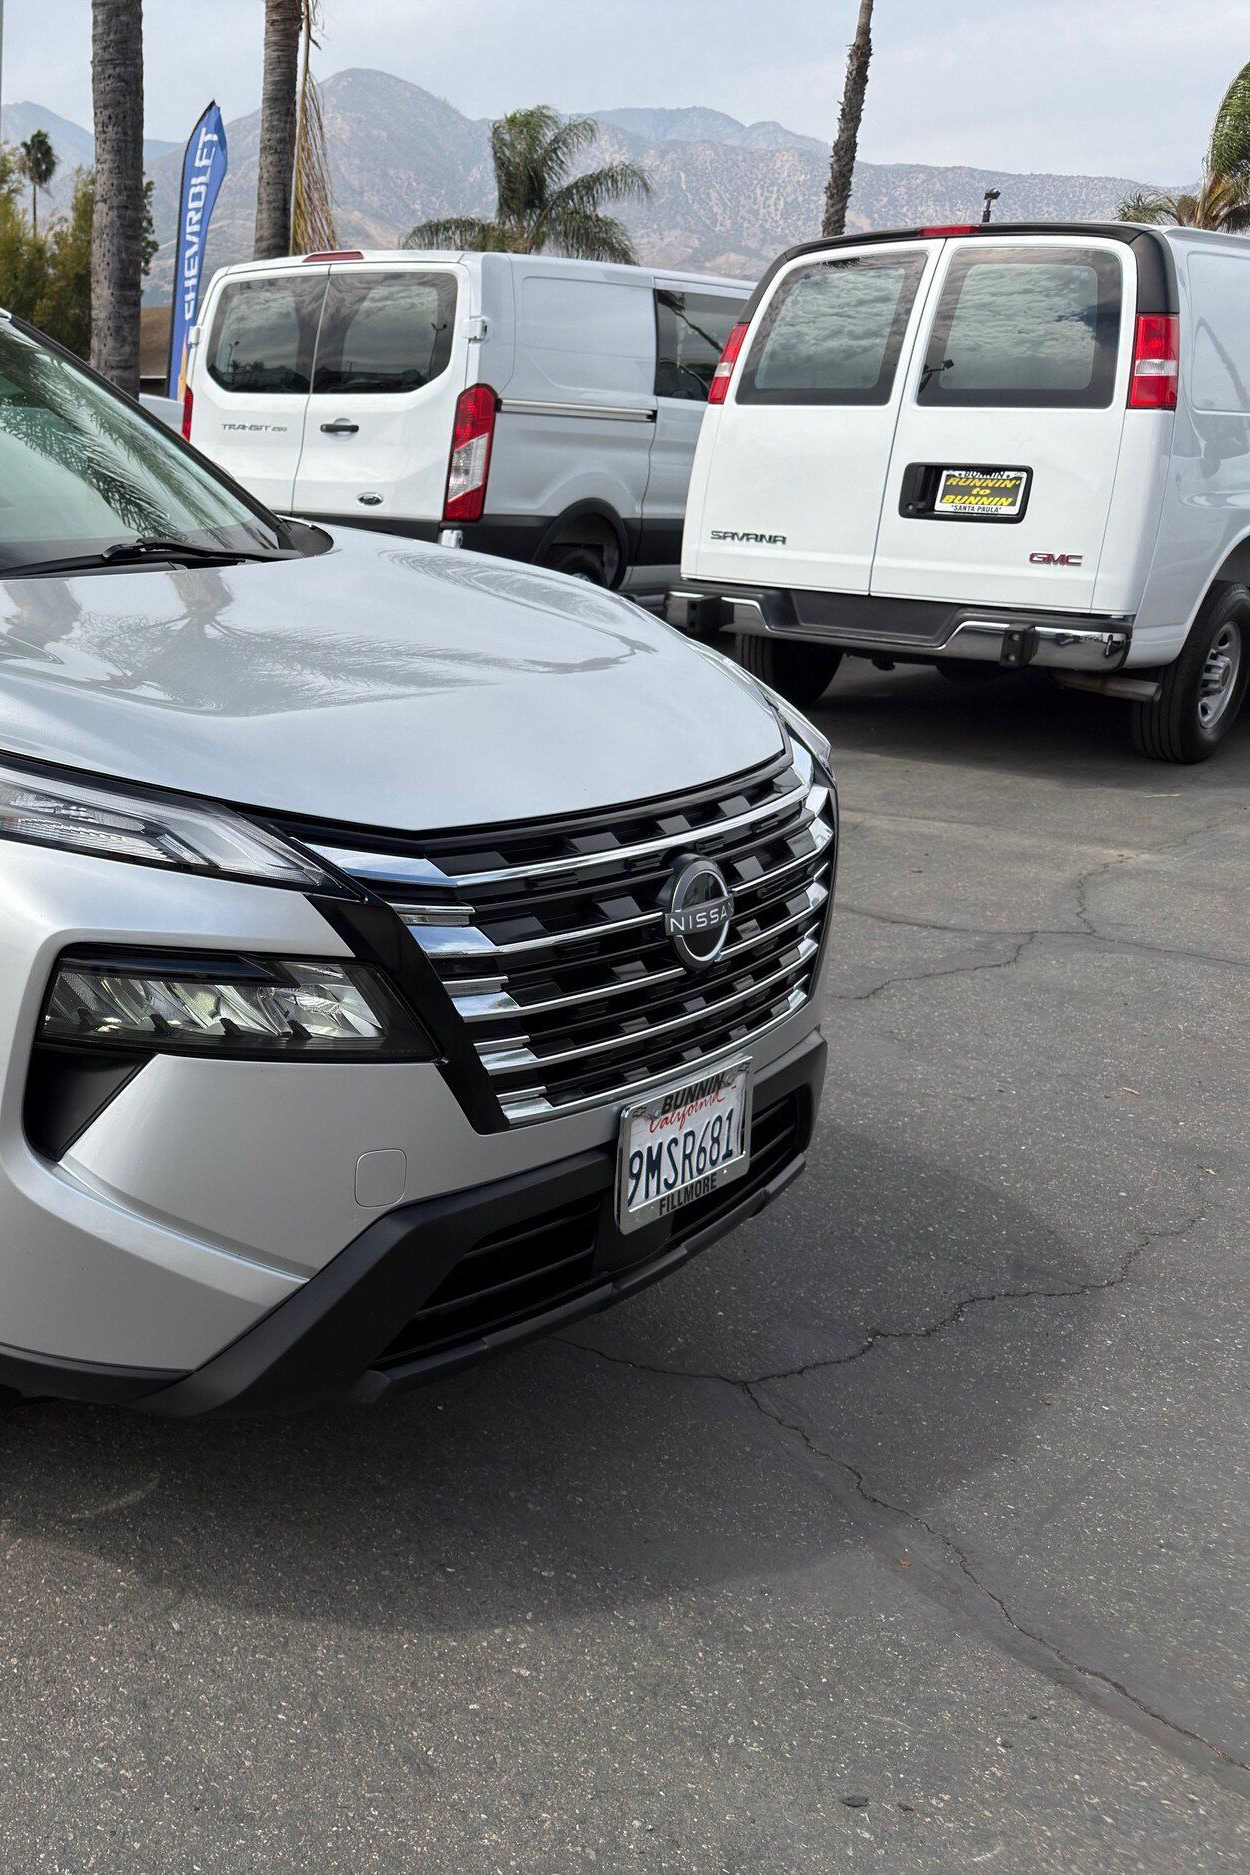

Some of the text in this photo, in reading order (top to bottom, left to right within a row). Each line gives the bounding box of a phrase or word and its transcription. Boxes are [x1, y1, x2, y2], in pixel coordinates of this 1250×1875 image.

[184, 127, 219, 320] CHEVROLET
[221, 423, 270, 431] TRANSIT
[946, 477, 1021, 488] RUNNIN'
[971, 487, 991, 495] to
[941, 495, 1013, 506] BUNNIN
[710, 530, 787, 545] SAVANA
[1029, 550, 1083, 567] GMC
[661, 1071, 725, 1116] BUNNIN
[649, 1090, 726, 1133] California
[627, 1107, 734, 1207] 9MSR681
[659, 1172, 717, 1216] FILLMORE
